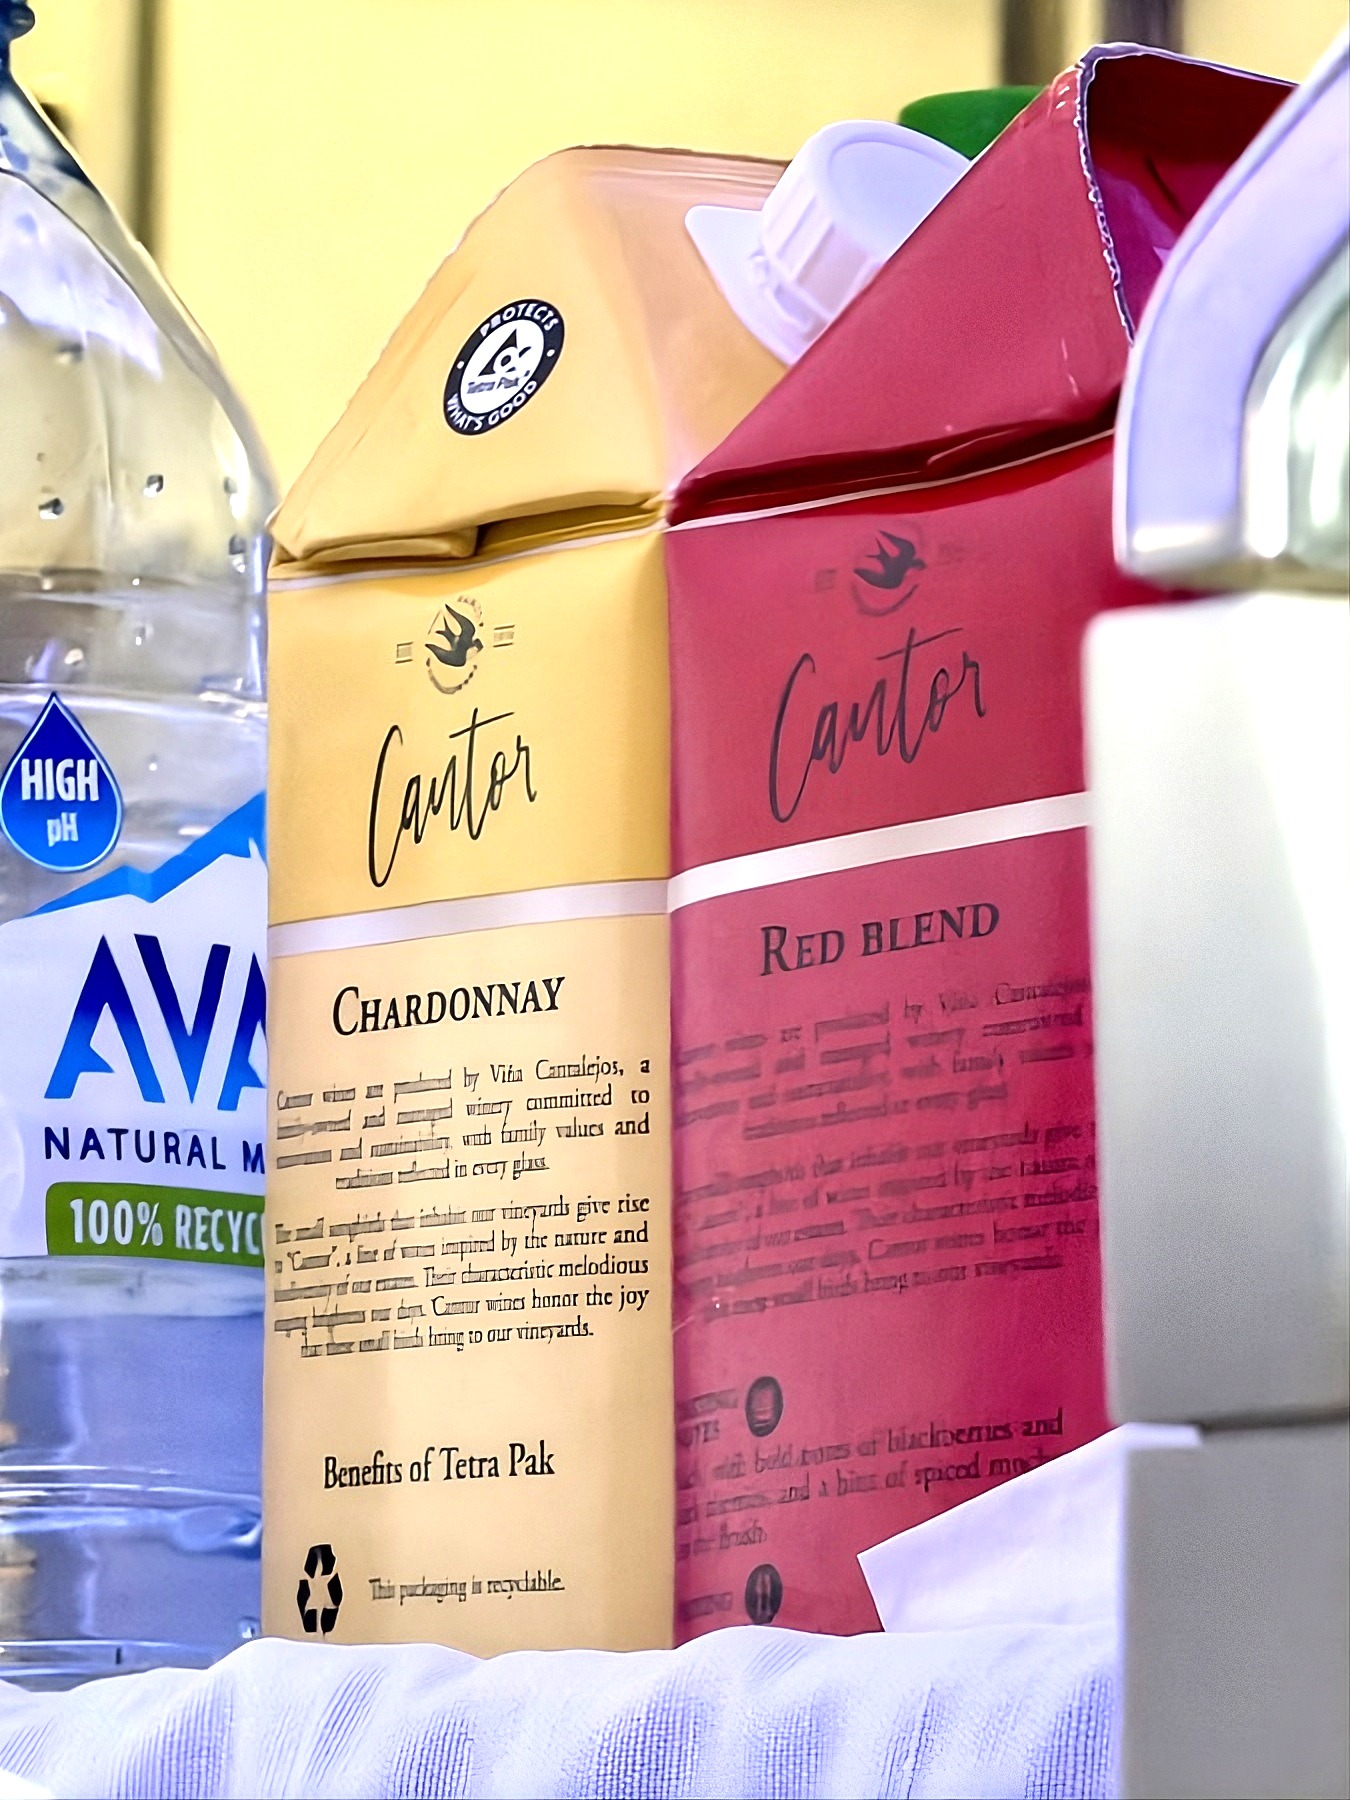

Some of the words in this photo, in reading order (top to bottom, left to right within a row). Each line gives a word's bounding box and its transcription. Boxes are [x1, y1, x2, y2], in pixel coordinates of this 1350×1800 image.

[480, 303, 559, 337] PROTECTS
[488, 380, 537, 425] GOOD
[769, 627, 986, 823] Cantor
[20, 758, 99, 802] HIGH
[369, 707, 537, 888] Cantor
[46, 812, 79, 848] pH
[332, 976, 566, 1036] CHARDONNAY
[640, 1059, 650, 1073] a
[631, 1090, 650, 1104] to
[614, 1112, 650, 1135] and
[45, 1127, 226, 1171] NATURAL
[577, 1195, 610, 1222] give
[618, 1194, 650, 1213] rise
[70, 1198, 164, 1247] 100%
[176, 1204, 265, 1255] RECYC
[502, 1230, 517, 1257] by
[614, 1221, 649, 1244] and
[559, 1253, 649, 1276] melodious
[532, 1288, 579, 1308] honor
[586, 1284, 613, 1306] the
[619, 1285, 650, 1312] joy
[324, 1450, 402, 1488] Benefits
[410, 1447, 435, 1482] of
[439, 1447, 499, 1480] Tetra
[508, 1440, 555, 1477] Pak
